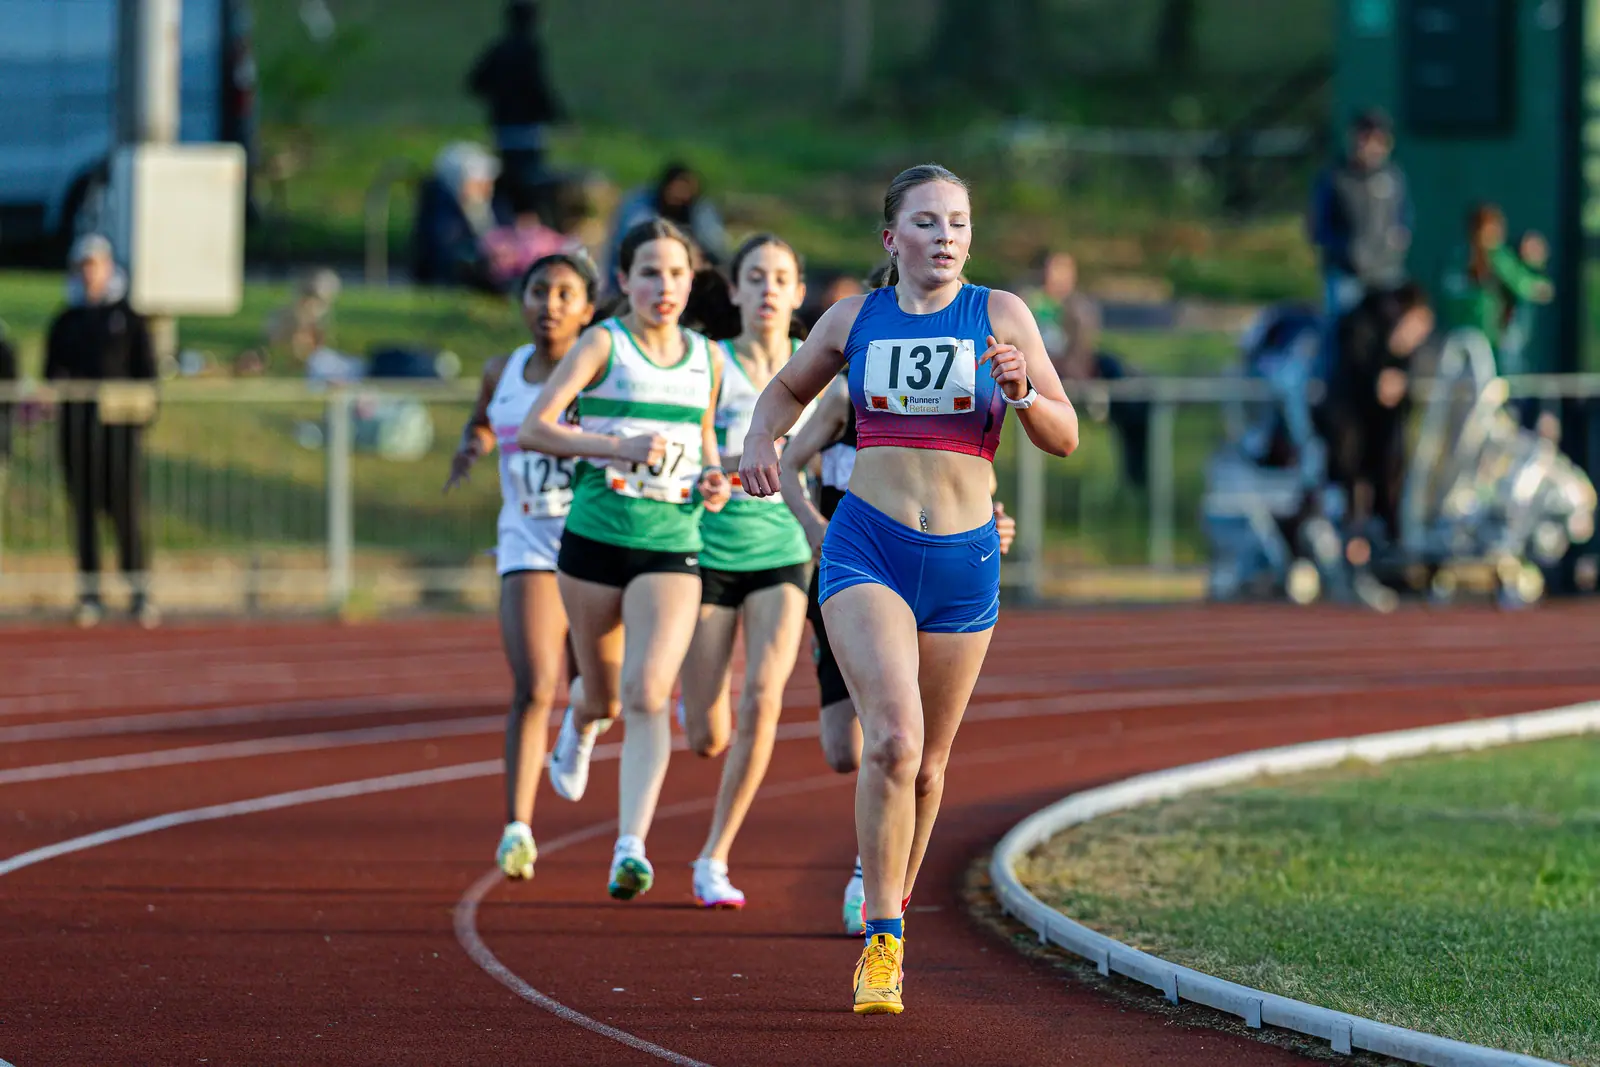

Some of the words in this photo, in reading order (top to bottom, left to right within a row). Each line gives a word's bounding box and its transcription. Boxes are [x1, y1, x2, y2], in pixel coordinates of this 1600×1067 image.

[888, 345, 957, 390] 137
[909, 396, 942, 404] Runners'
[909, 404, 940, 413] Retreat
[524, 457, 572, 495] 125
